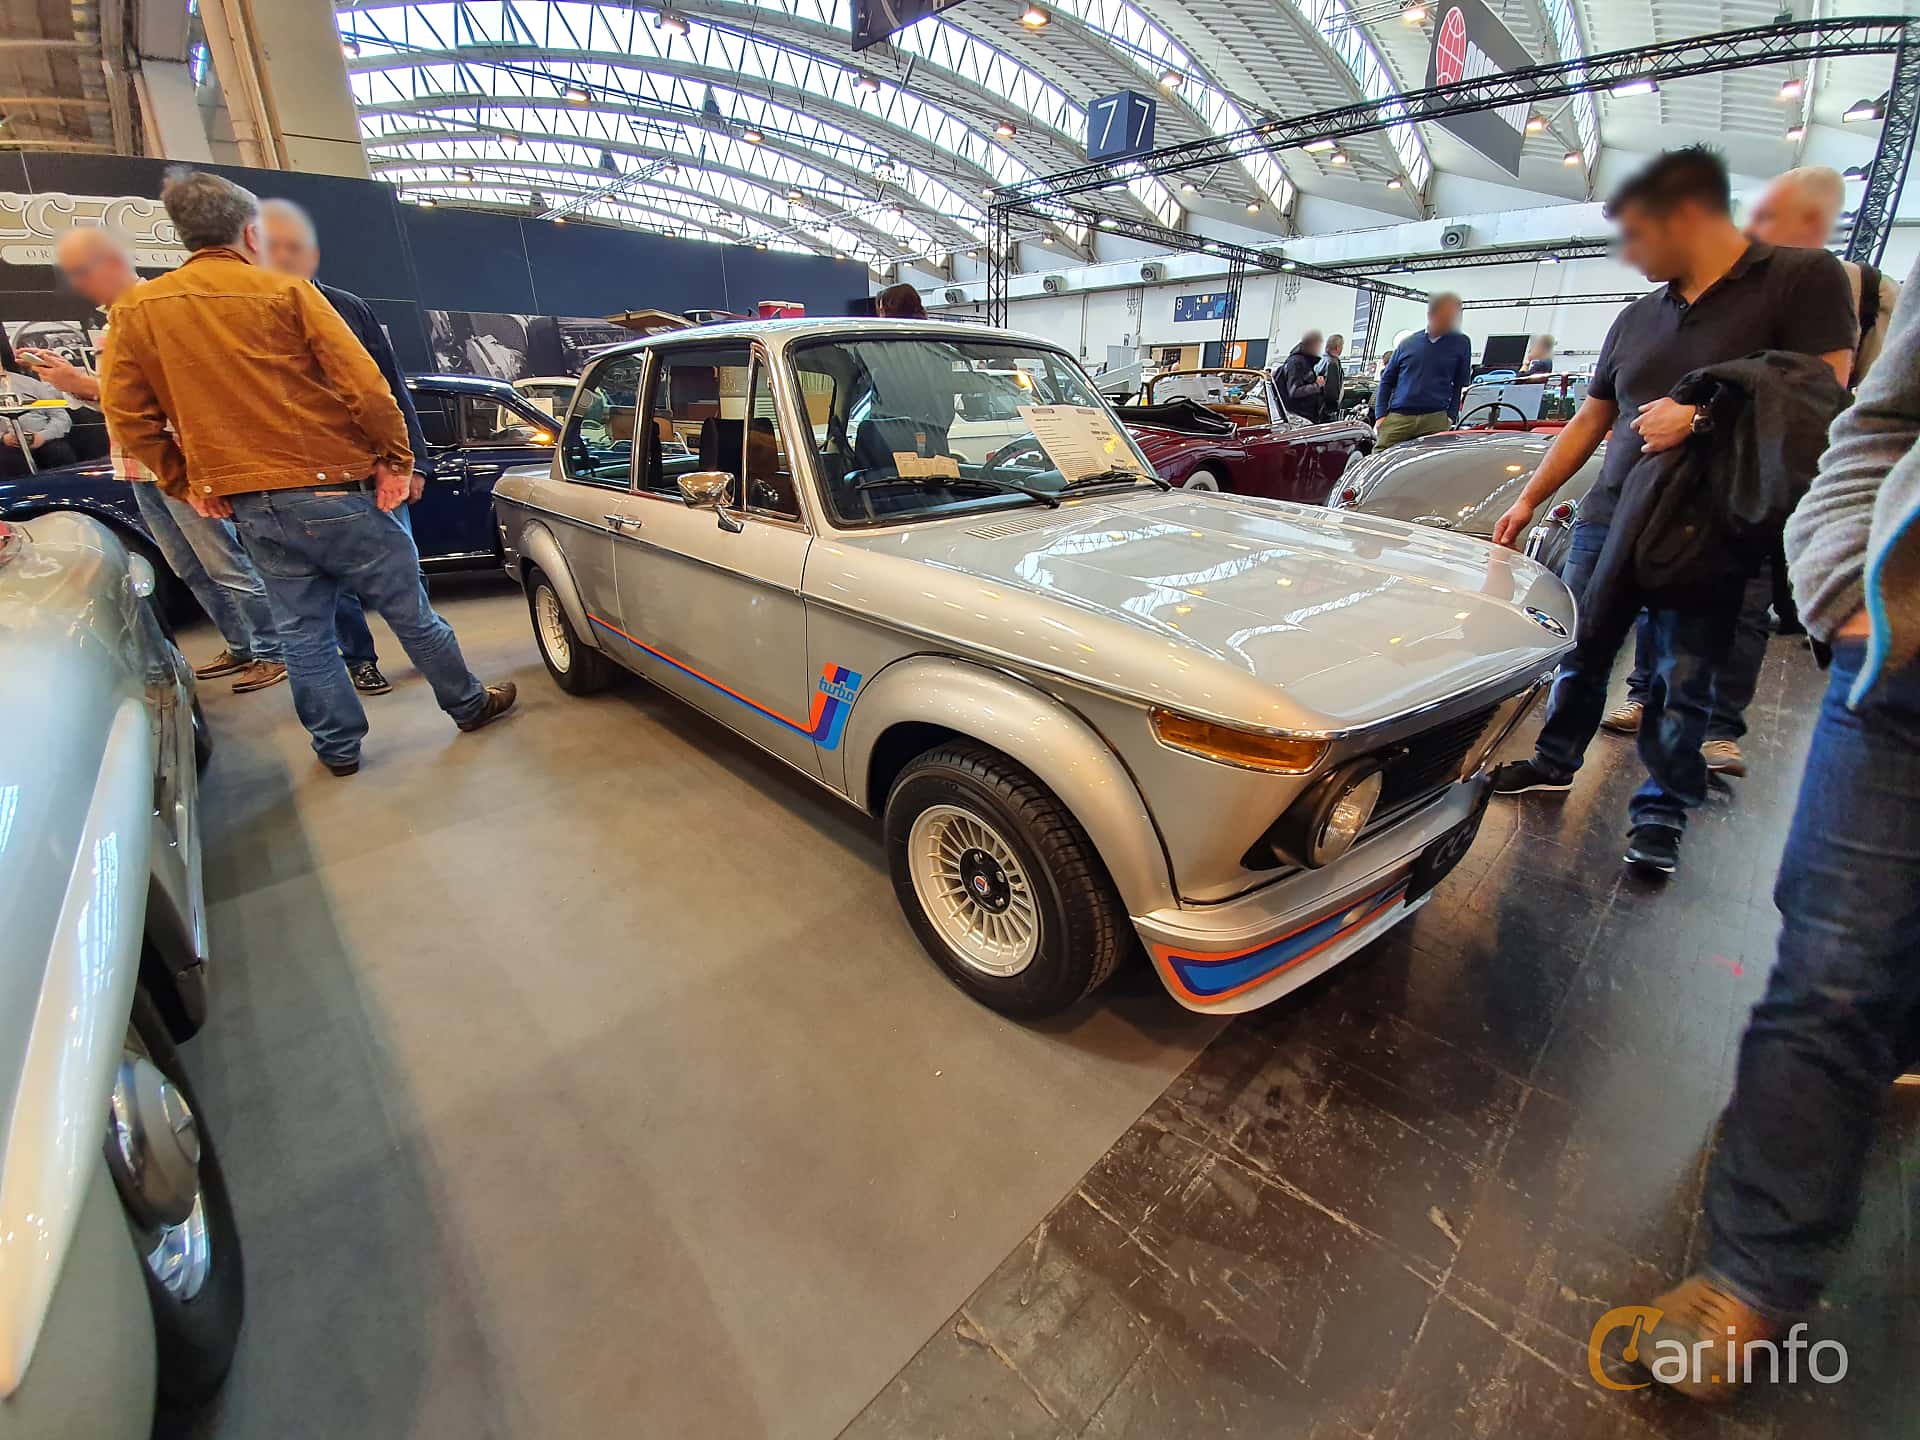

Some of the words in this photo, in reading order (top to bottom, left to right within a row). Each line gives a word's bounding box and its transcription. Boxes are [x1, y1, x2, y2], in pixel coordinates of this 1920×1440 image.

[1098, 99, 1118, 150] 7
[1135, 99, 1150, 148] 7
[1176, 298, 1183, 311] 8
[819, 676, 855, 703] turbo
